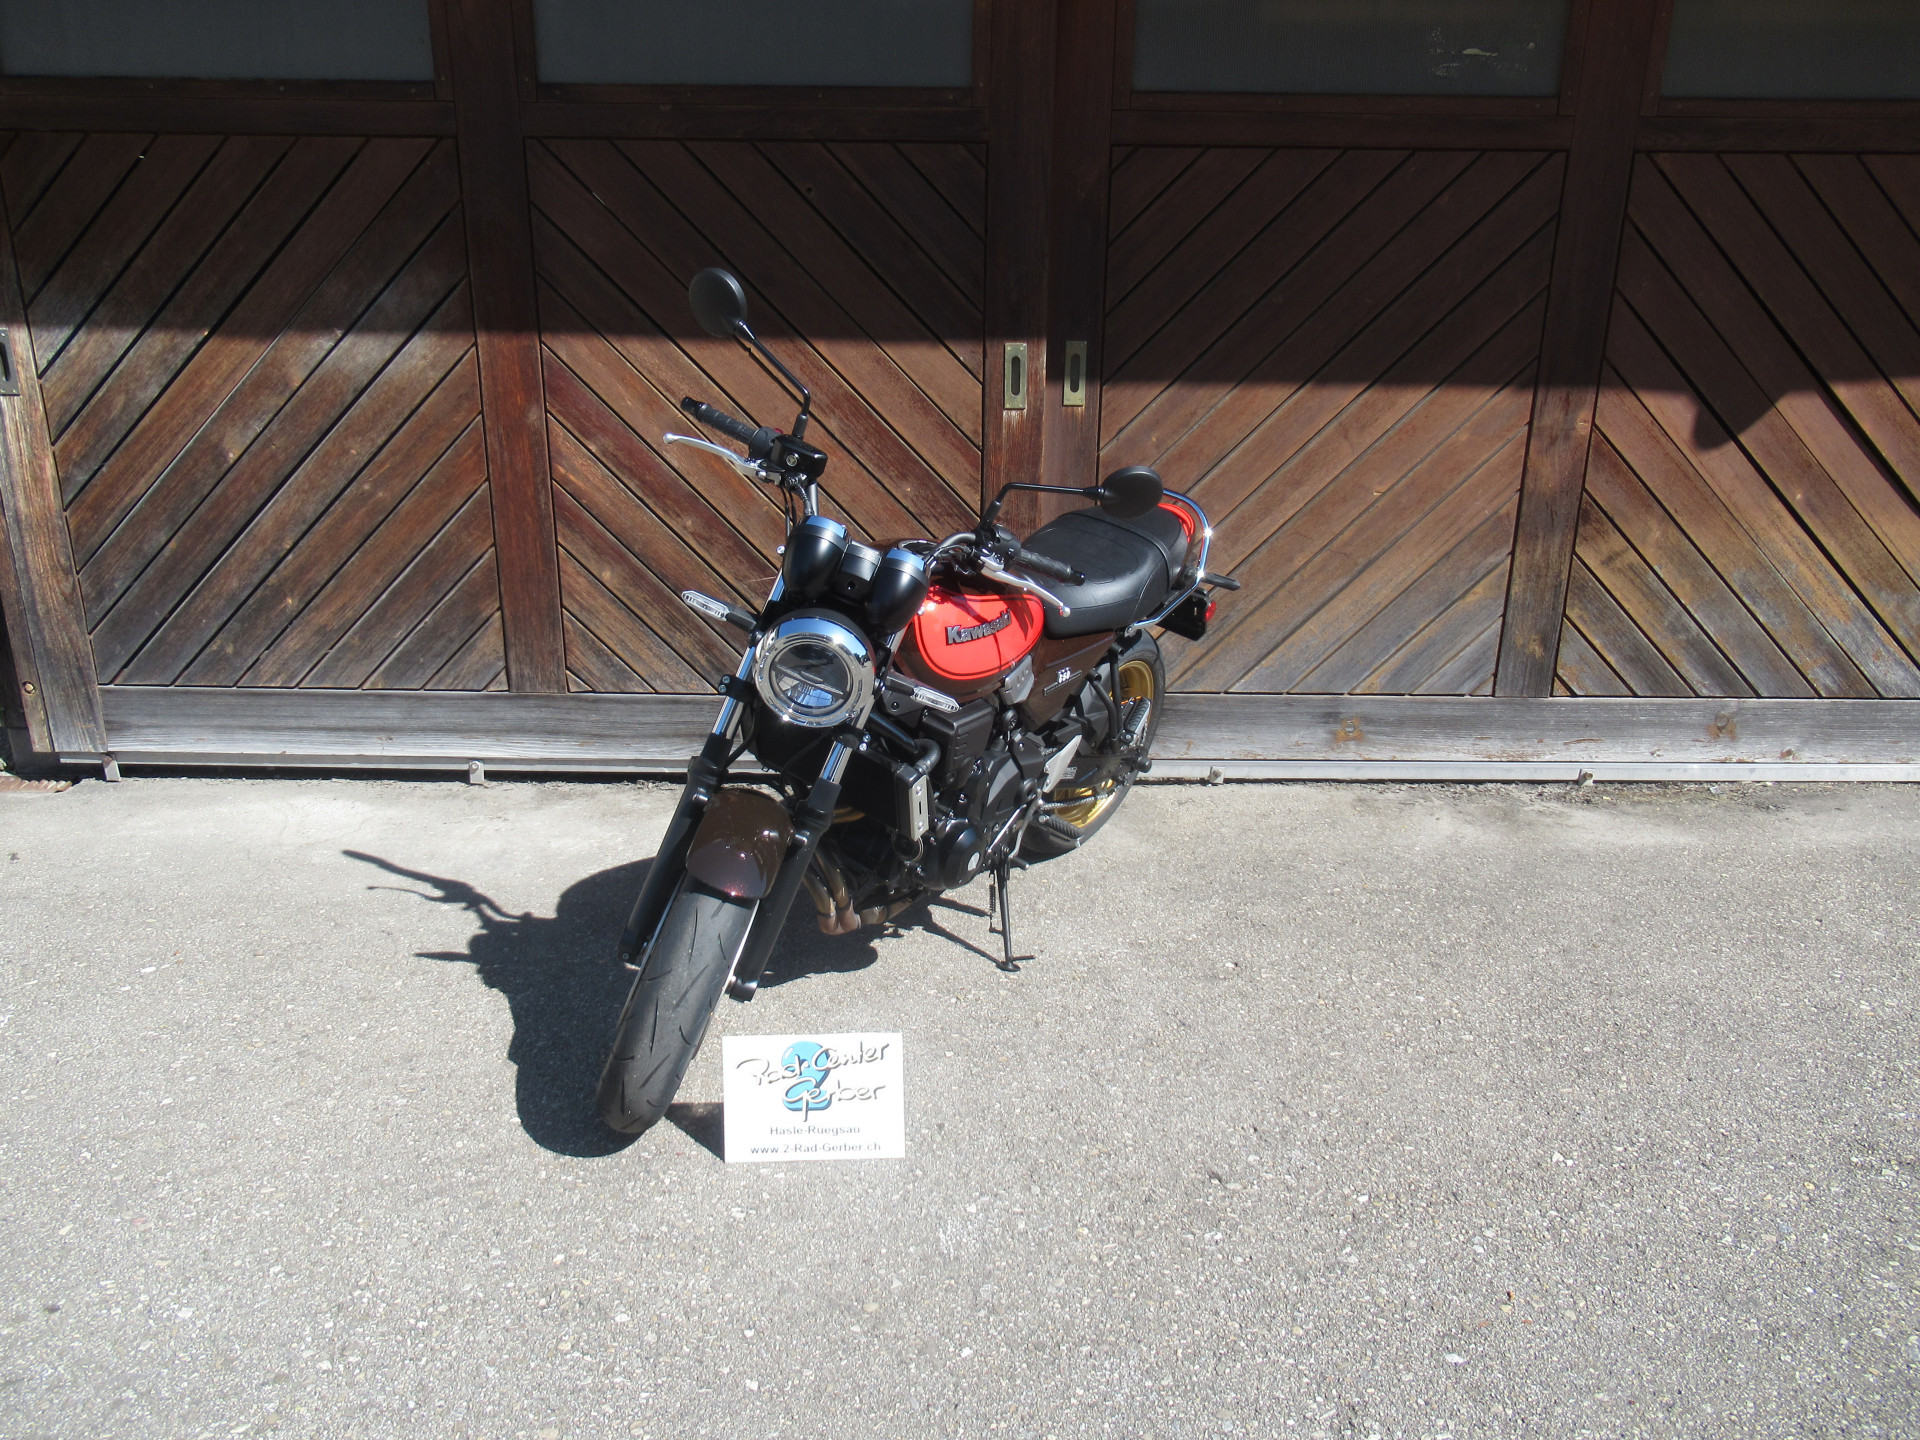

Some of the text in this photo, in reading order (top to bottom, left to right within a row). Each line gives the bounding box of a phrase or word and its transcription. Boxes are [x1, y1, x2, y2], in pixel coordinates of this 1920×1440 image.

[946, 609, 1012, 646] Kawasaki
[783, 1077, 886, 1122] Gerber
[769, 1125, 861, 1137] Hasle-Ruegsau
[750, 1142, 881, 1154] www.2-Rad-Gerber.ch
